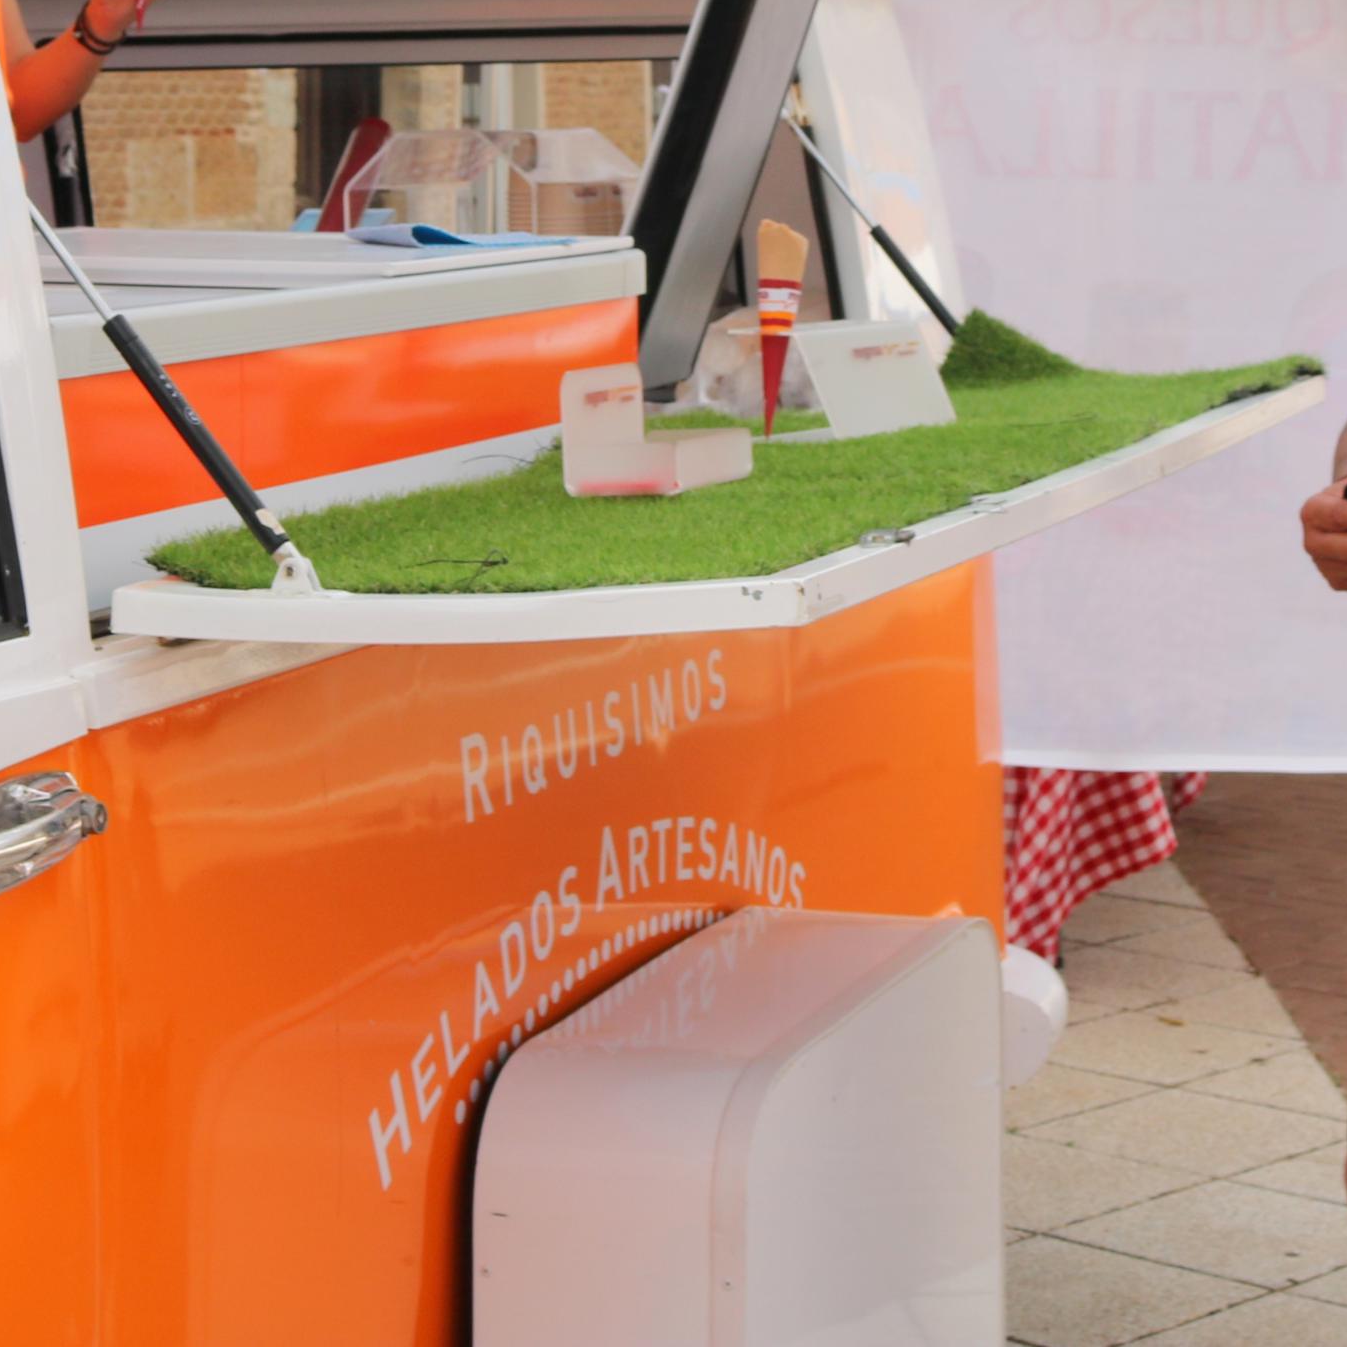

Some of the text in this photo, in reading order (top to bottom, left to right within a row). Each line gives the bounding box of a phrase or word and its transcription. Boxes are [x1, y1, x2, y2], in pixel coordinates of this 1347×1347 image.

[460, 648, 728, 825] RIQUISIMOS
[367, 865, 581, 1193] HELADOS
[595, 815, 807, 912] ARTESANOS
